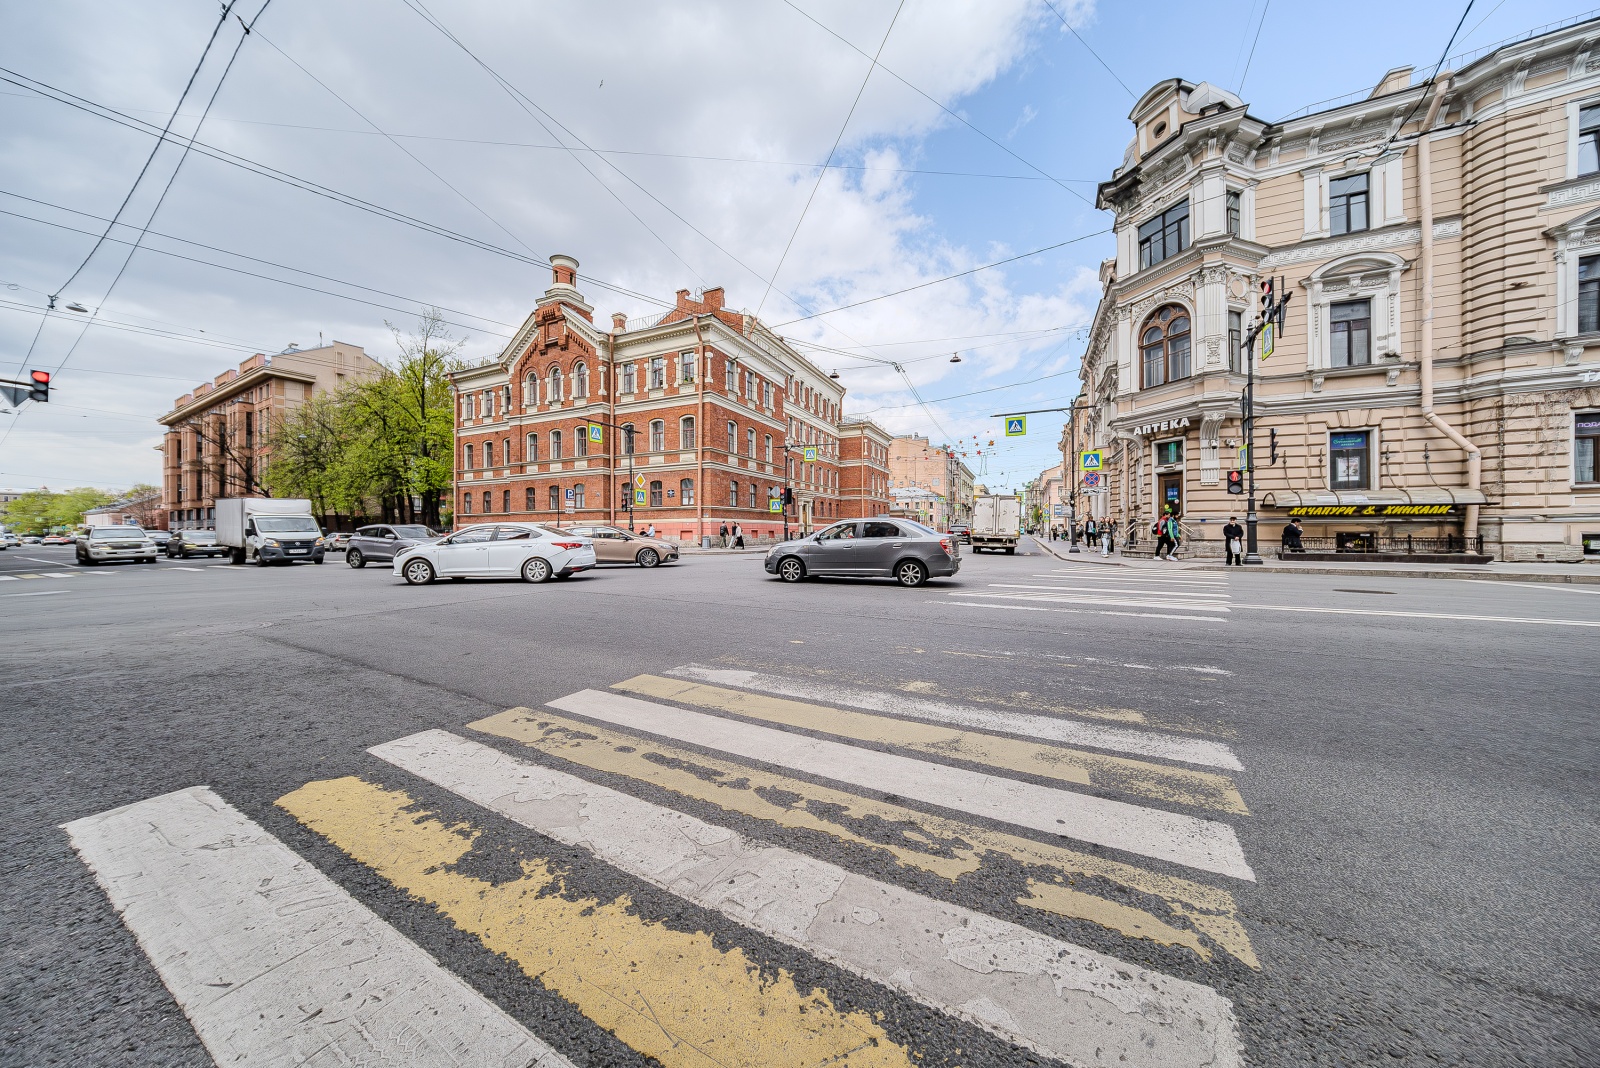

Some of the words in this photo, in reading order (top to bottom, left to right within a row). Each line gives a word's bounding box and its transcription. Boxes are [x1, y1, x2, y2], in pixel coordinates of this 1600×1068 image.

[1133, 418, 1190, 435] АПТЕКА
[1289, 506, 1356, 515] ХАЧАПУРИ
[1362, 506, 1375, 515] &
[1384, 505, 1452, 514] ХИНКАЛИ
